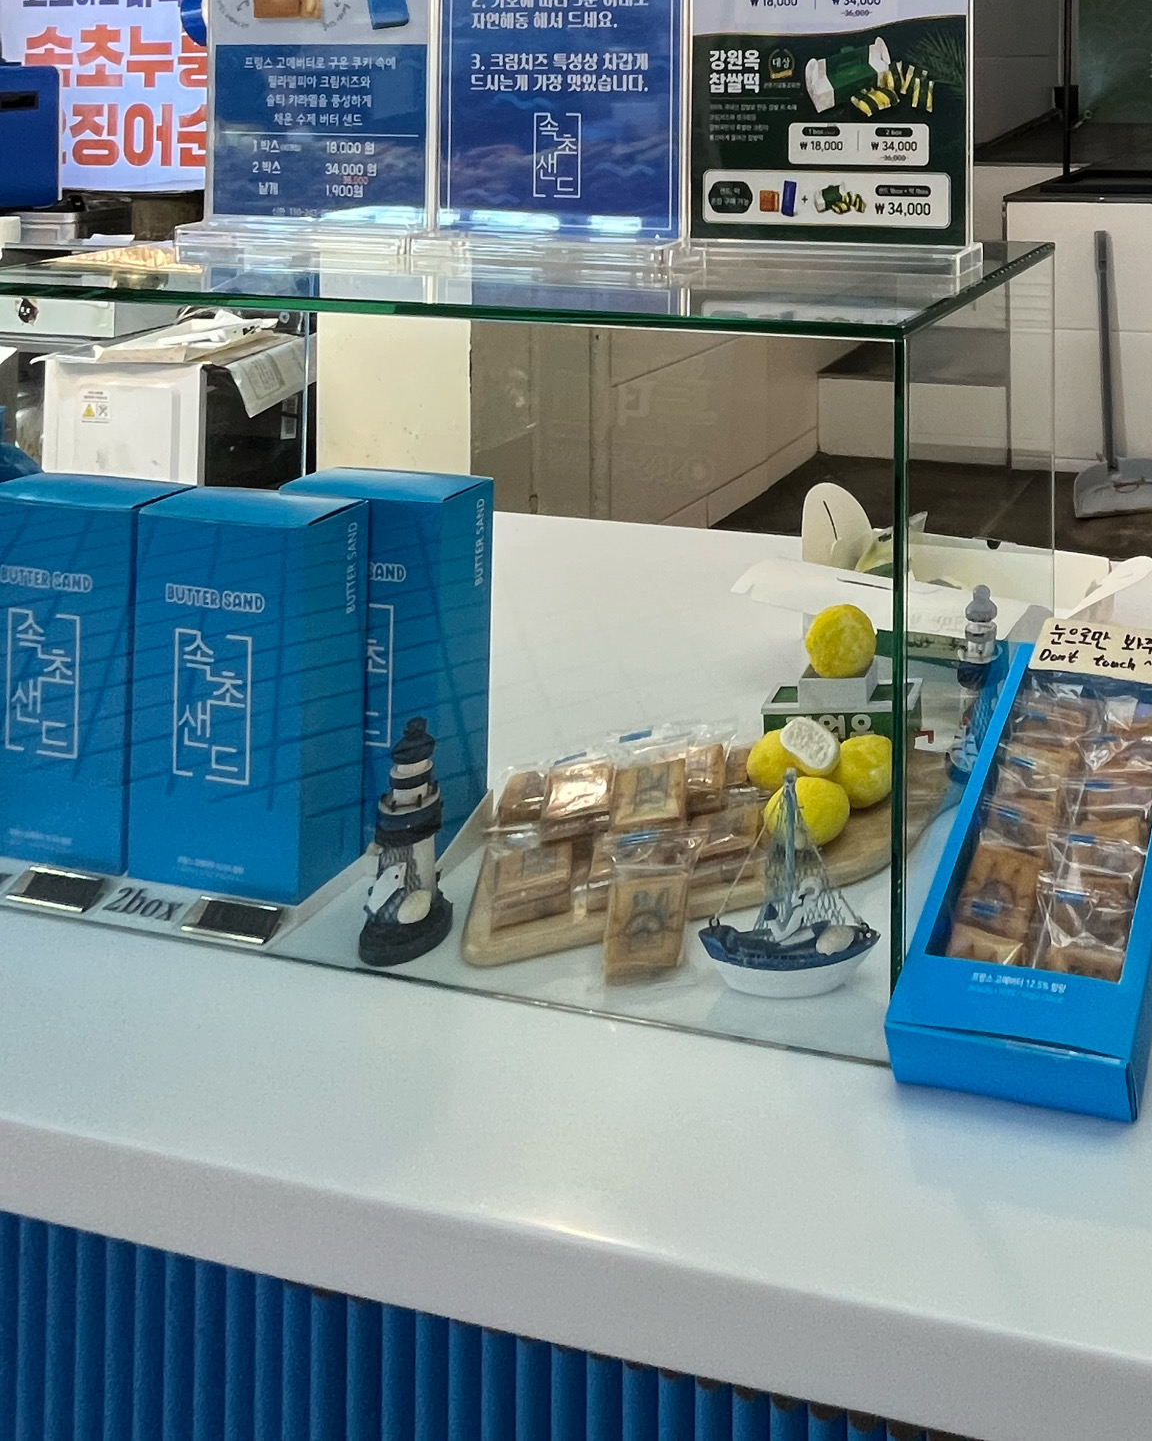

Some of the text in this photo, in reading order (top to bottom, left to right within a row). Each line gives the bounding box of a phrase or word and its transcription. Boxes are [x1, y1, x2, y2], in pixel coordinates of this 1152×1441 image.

[471, 12, 618, 30] 자연해동 해서 드세요.
[471, 53, 649, 71] 3. 크림치즈 특성상 차갑게
[709, 49, 760, 70] 강원옥
[319, 75, 371, 89] 크림치즈와
[470, 74, 649, 92] 드시는게 가장 맛있습니다.
[709, 72, 760, 94] 찹쌀떡
[331, 95, 372, 108] 풍성하게
[296, 114, 317, 126] 수제
[319, 114, 339, 126] 버터
[364, 141, 375, 155] 원
[533, 112, 581, 198] 속초샌드
[811, 141, 843, 152] 18,000
[882, 141, 917, 152] 34,000
[252, 161, 259, 173] 2
[367, 162, 377, 177] 원
[888, 202, 931, 216] 34,000
[474, 498, 485, 587] BUTTER SAND
[346, 522, 358, 615] BUTTER SAND
[0, 564, 93, 593] BUTTER SAND
[165, 583, 265, 613] BUTTER SAND
[1050, 624, 1111, 650] 눈으로만
[1093, 654, 1136, 671] touch
[5, 608, 80, 758] 속초샌드
[174, 629, 252, 785] 속초샌드
[102, 886, 185, 922] 2box
